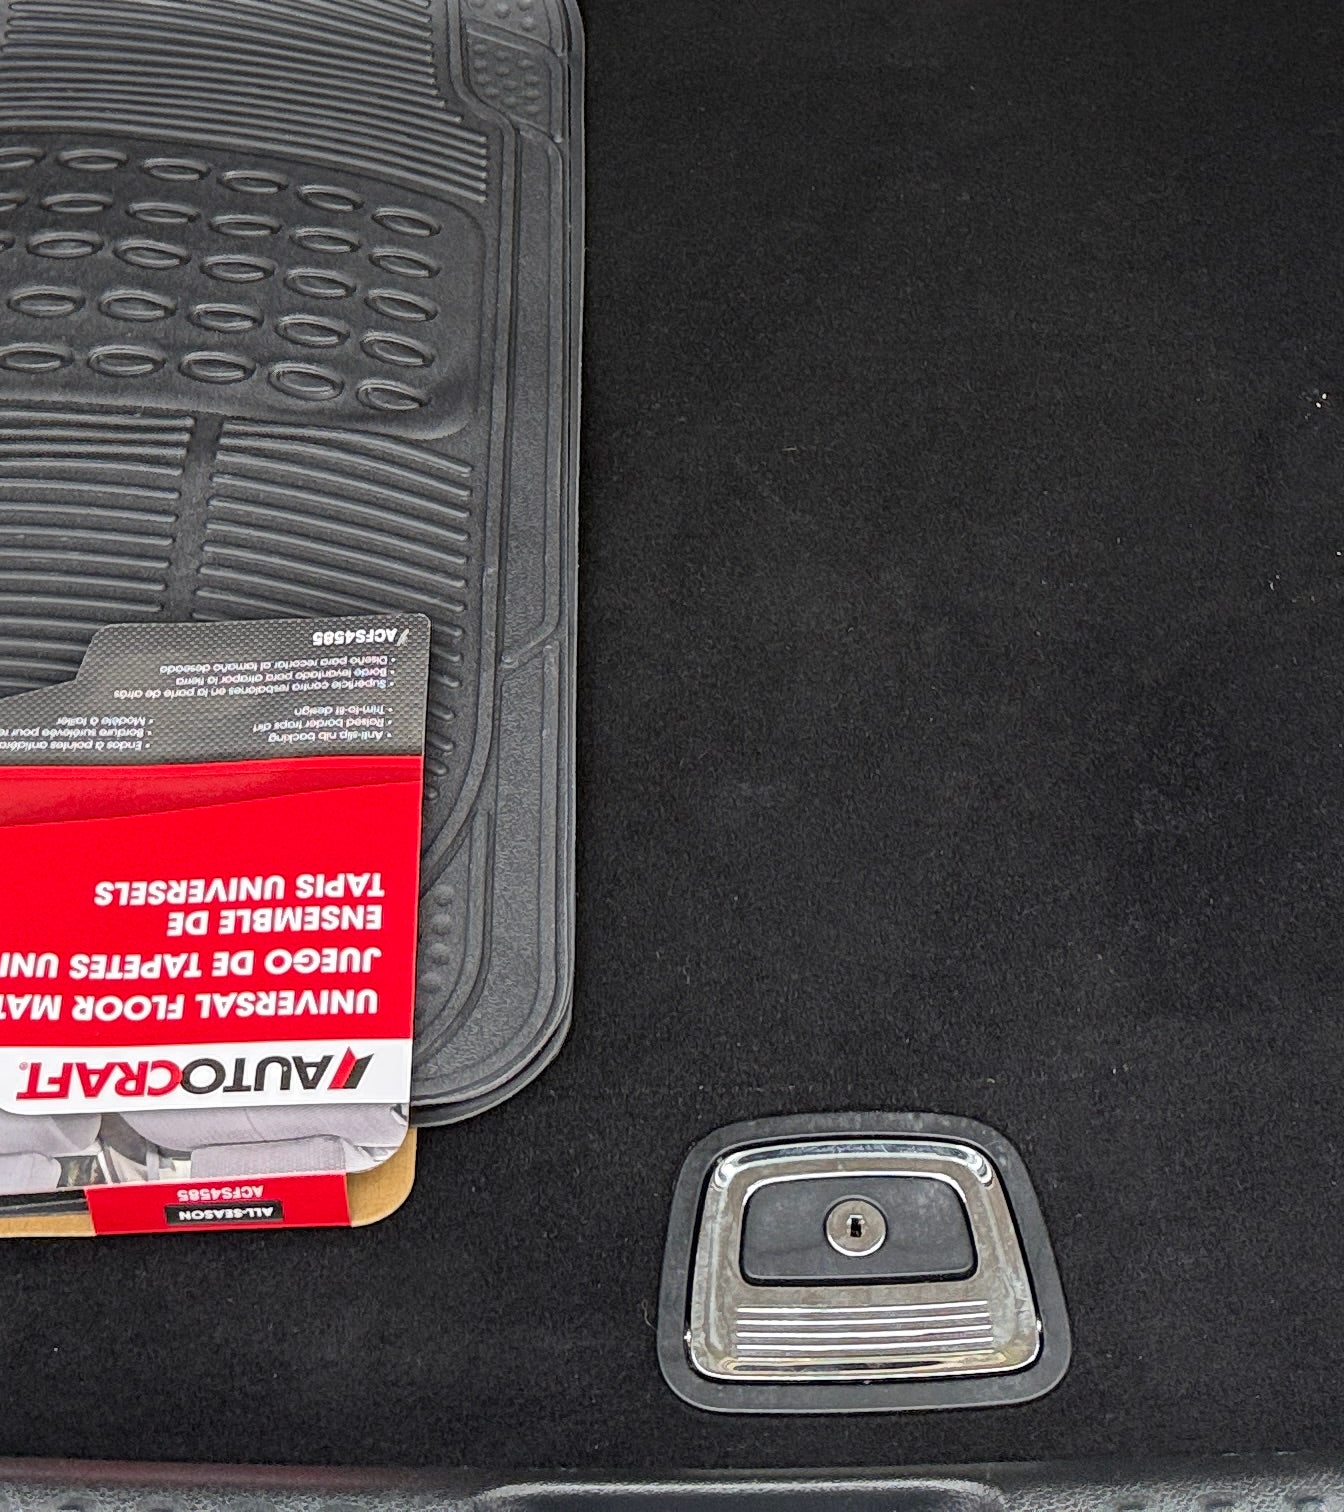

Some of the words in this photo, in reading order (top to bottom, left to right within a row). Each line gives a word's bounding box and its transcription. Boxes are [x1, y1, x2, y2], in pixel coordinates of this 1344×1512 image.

[312, 628, 397, 646] ACFS4585
[294, 705, 333, 716] design
[345, 717, 384, 729] Raised
[305, 718, 343, 730] border
[318, 731, 336, 742] nib
[268, 731, 315, 744] backing
[94, 875, 286, 907] UNIVERSELS
[295, 872, 385, 899] TAPIS
[166, 910, 209, 936] DE
[218, 904, 382, 935] ENSEMBLE
[69, 952, 202, 980] TAPETES
[211, 950, 254, 977] DE
[264, 947, 382, 975] JUEGO
[71, 993, 185, 1022] FLOOR
[195, 989, 378, 1019] UNIVERSAL
[177, 1185, 264, 1202] ACFS4585
[178, 1206, 274, 1221] ALL-SEASON
